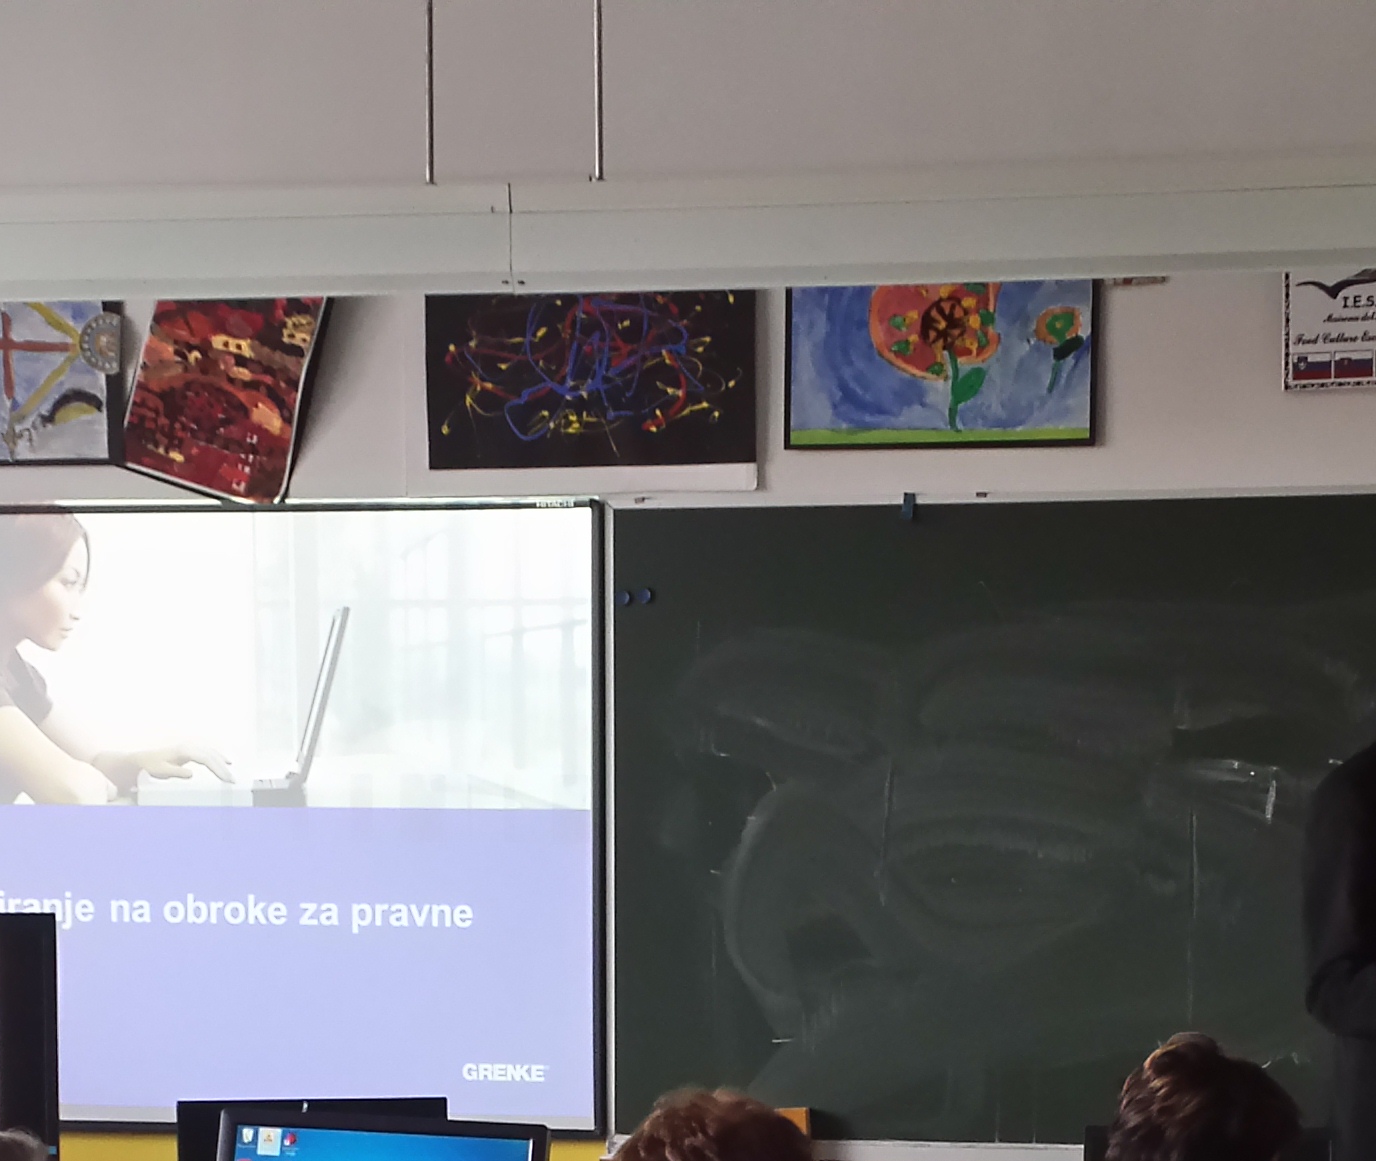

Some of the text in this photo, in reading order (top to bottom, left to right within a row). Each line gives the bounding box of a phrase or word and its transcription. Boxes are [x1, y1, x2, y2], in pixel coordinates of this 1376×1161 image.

[1293, 332, 1319, 346] Food
[1321, 332, 1359, 344] Culture
[110, 898, 151, 924] na
[163, 892, 287, 926] obroke
[299, 901, 339, 927] za
[351, 901, 474, 933] pravne
[462, 1062, 545, 1082] GRENKE
